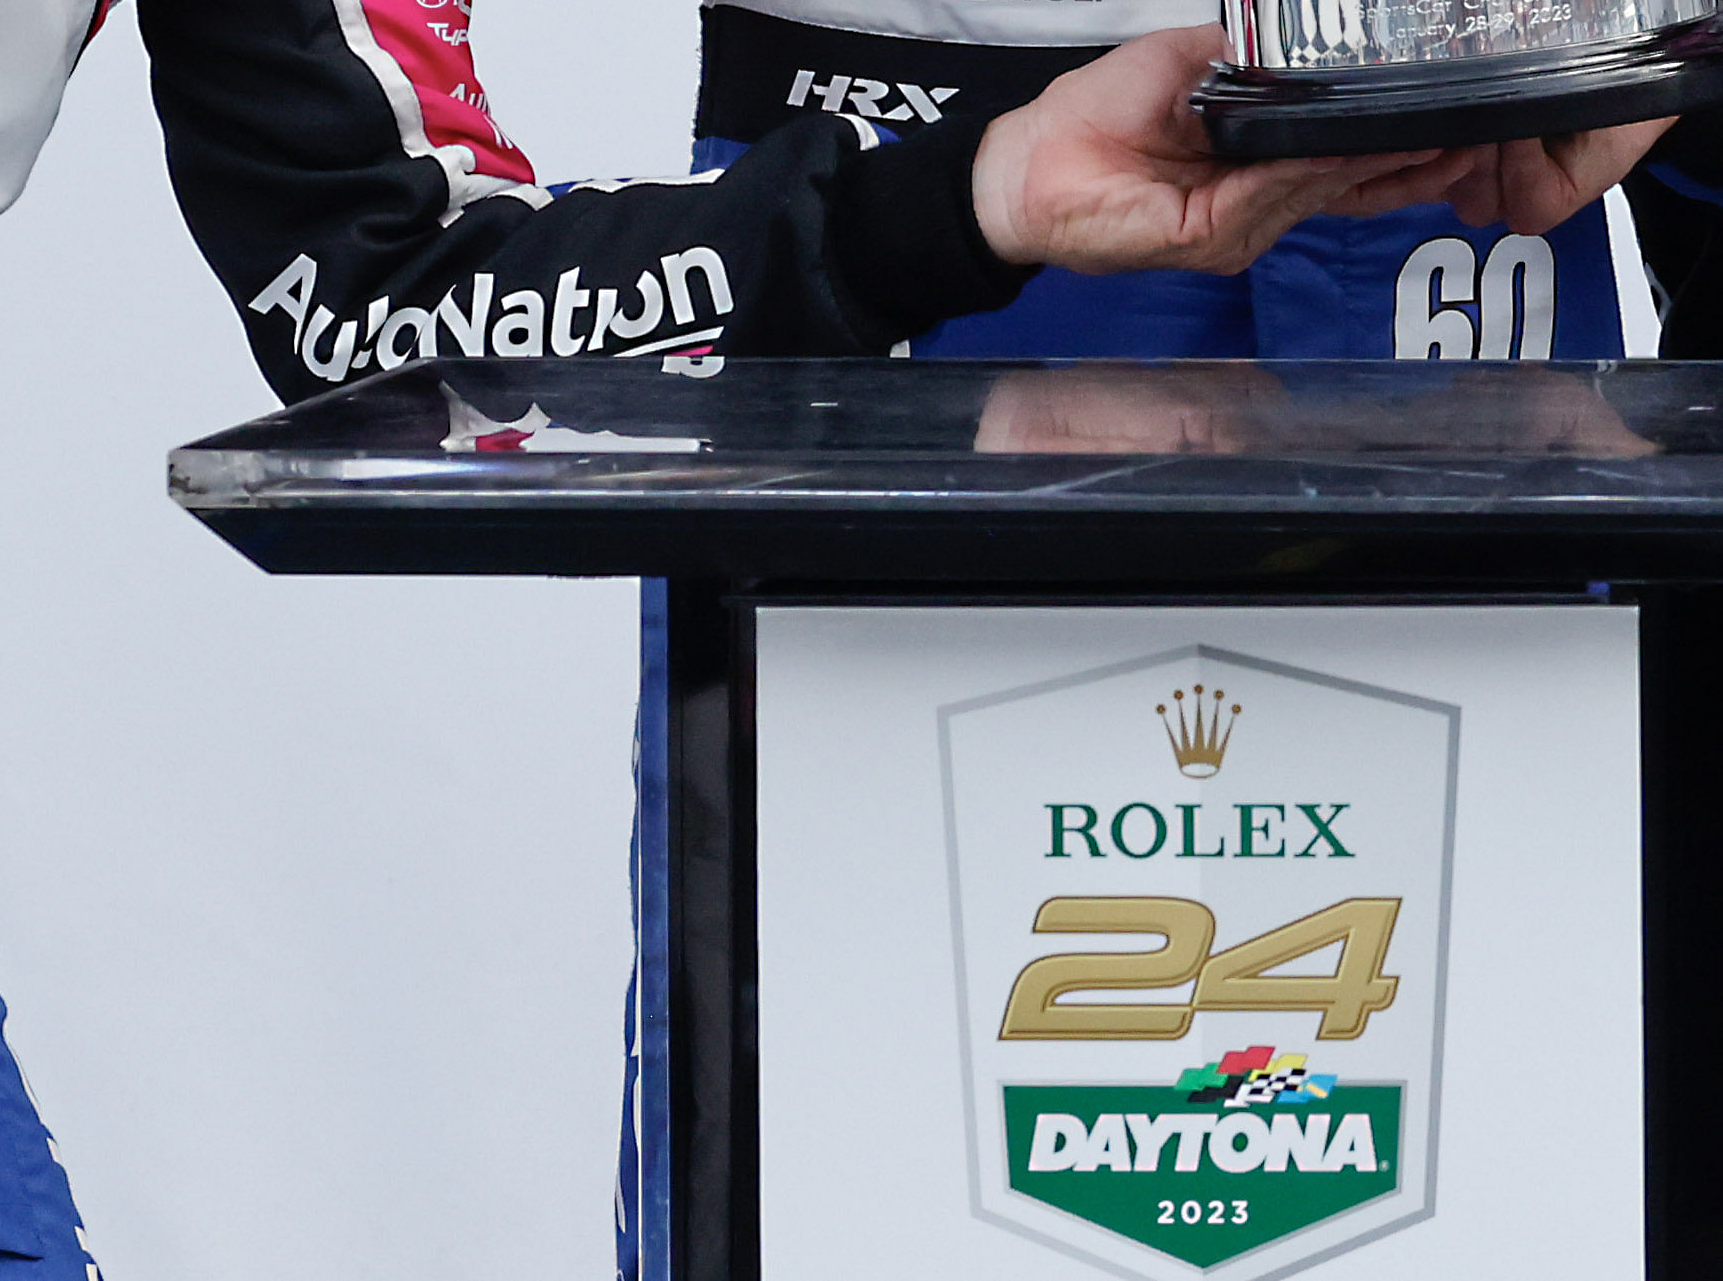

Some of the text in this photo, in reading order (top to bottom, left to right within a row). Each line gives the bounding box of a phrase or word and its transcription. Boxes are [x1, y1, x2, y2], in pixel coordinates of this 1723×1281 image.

[786, 69, 961, 125] HRX
[1392, 232, 1557, 360] 60
[1044, 802, 1356, 860] ROLEX
[998, 896, 1403, 1041] 24
[1028, 1113, 1377, 1174] DAYTONA
[1157, 1200, 1249, 1226] 2023
